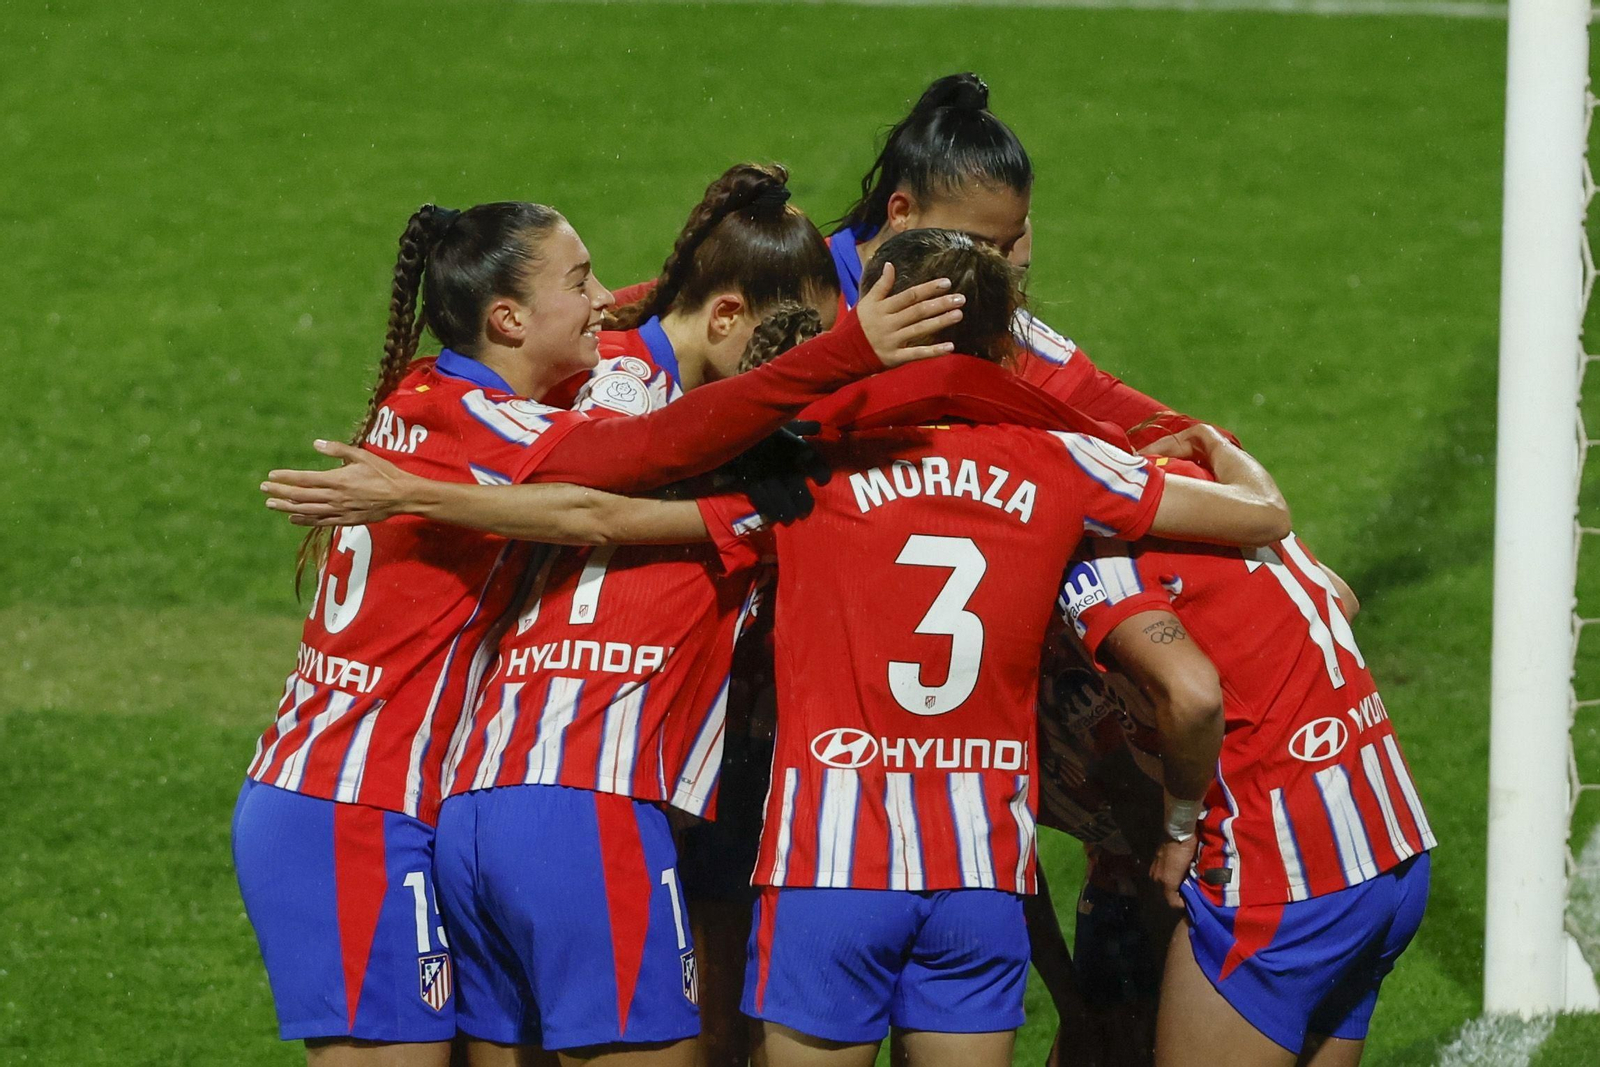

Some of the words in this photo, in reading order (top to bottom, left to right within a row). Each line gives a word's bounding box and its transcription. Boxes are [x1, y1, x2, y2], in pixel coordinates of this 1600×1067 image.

[849, 456, 1037, 524] MORAZA
[887, 533, 988, 717] 3
[1070, 589, 1106, 618] aken
[881, 736, 1029, 771] HYUND
